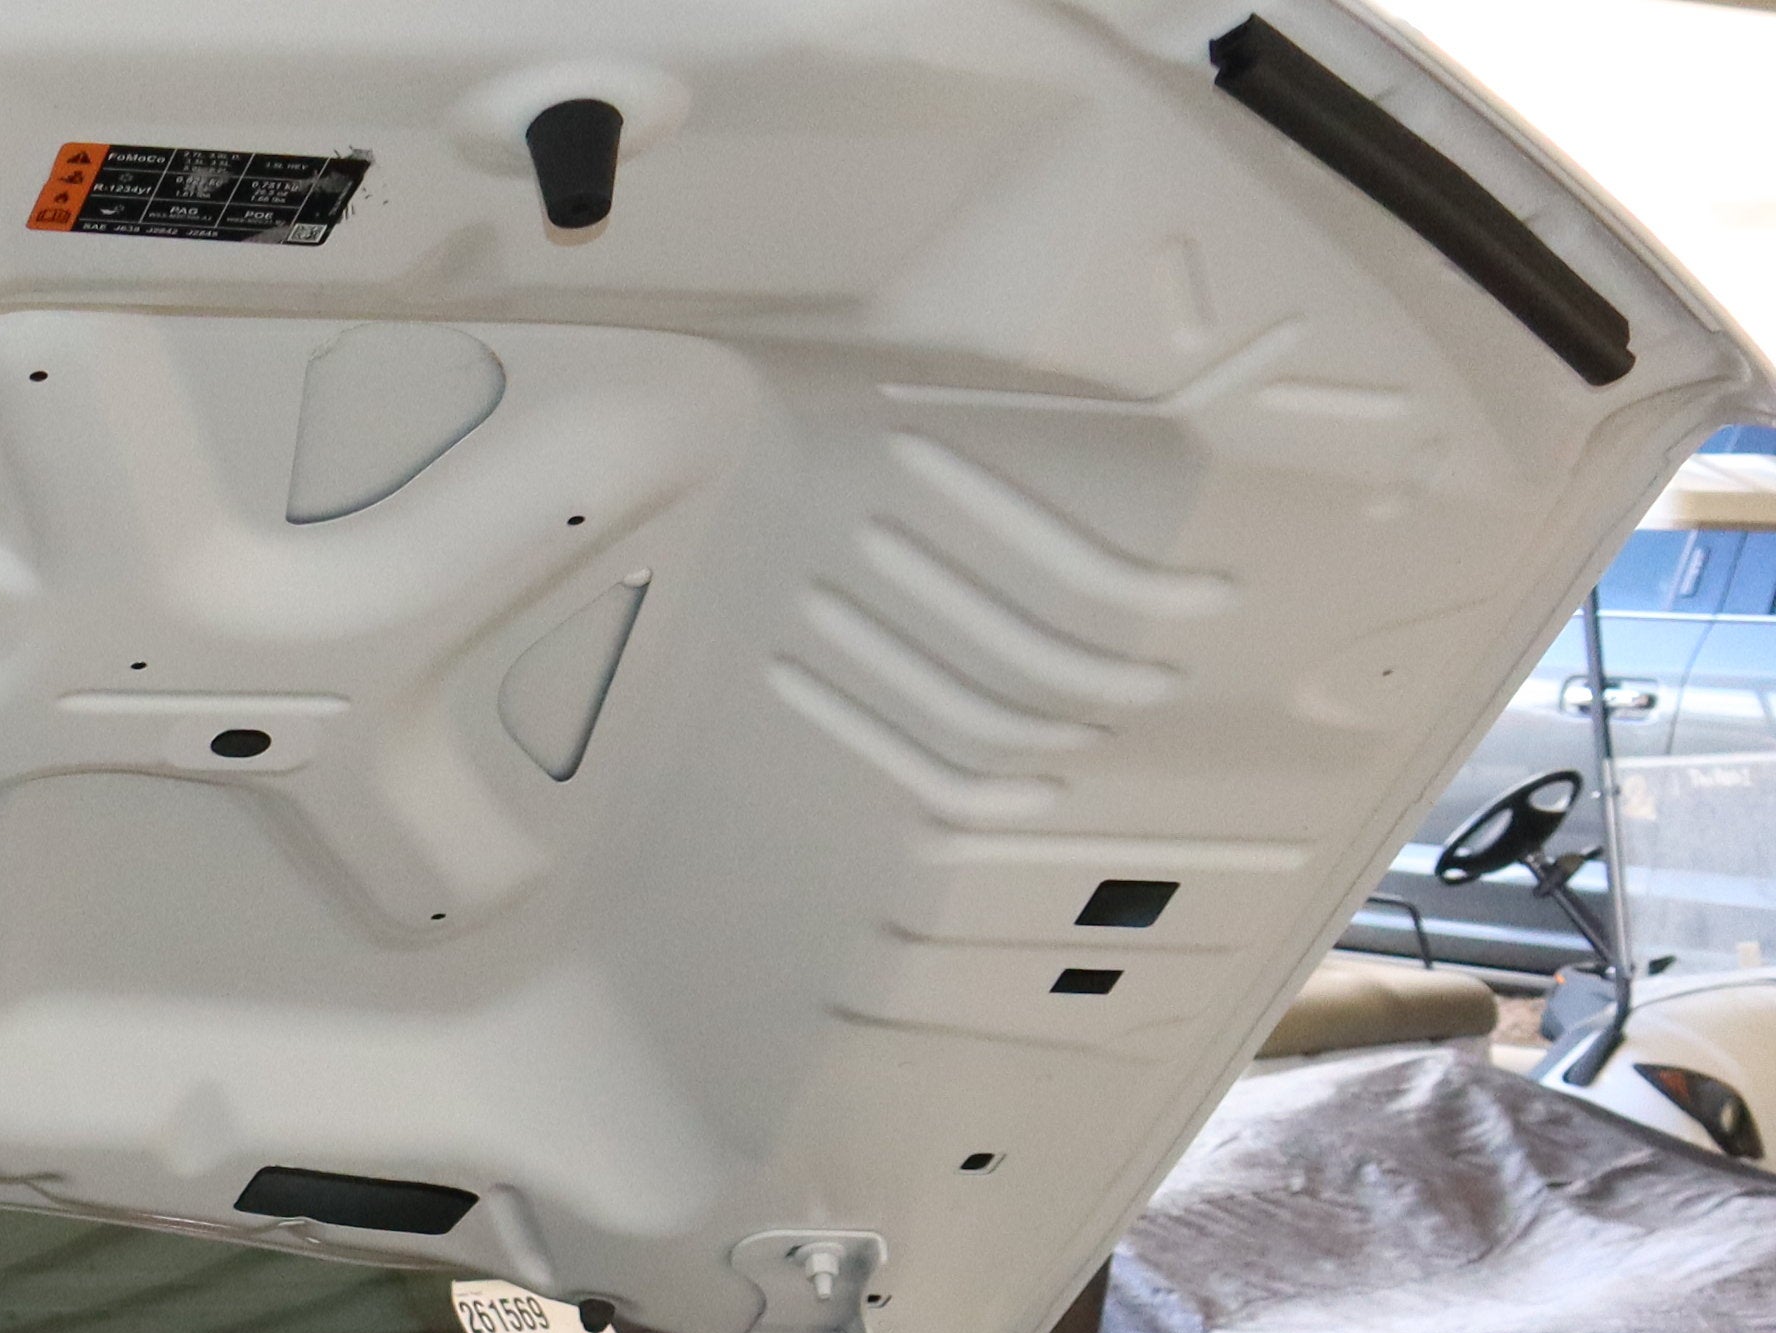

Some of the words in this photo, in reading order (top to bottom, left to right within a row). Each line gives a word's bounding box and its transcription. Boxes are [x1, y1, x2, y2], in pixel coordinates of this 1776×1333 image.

[108, 152, 166, 164] FoMoCo
[93, 183, 152, 195] R-1234yf
[169, 205, 199, 215] PAG
[244, 210, 274, 219] POE
[459, 1295, 550, 1333] 261569
